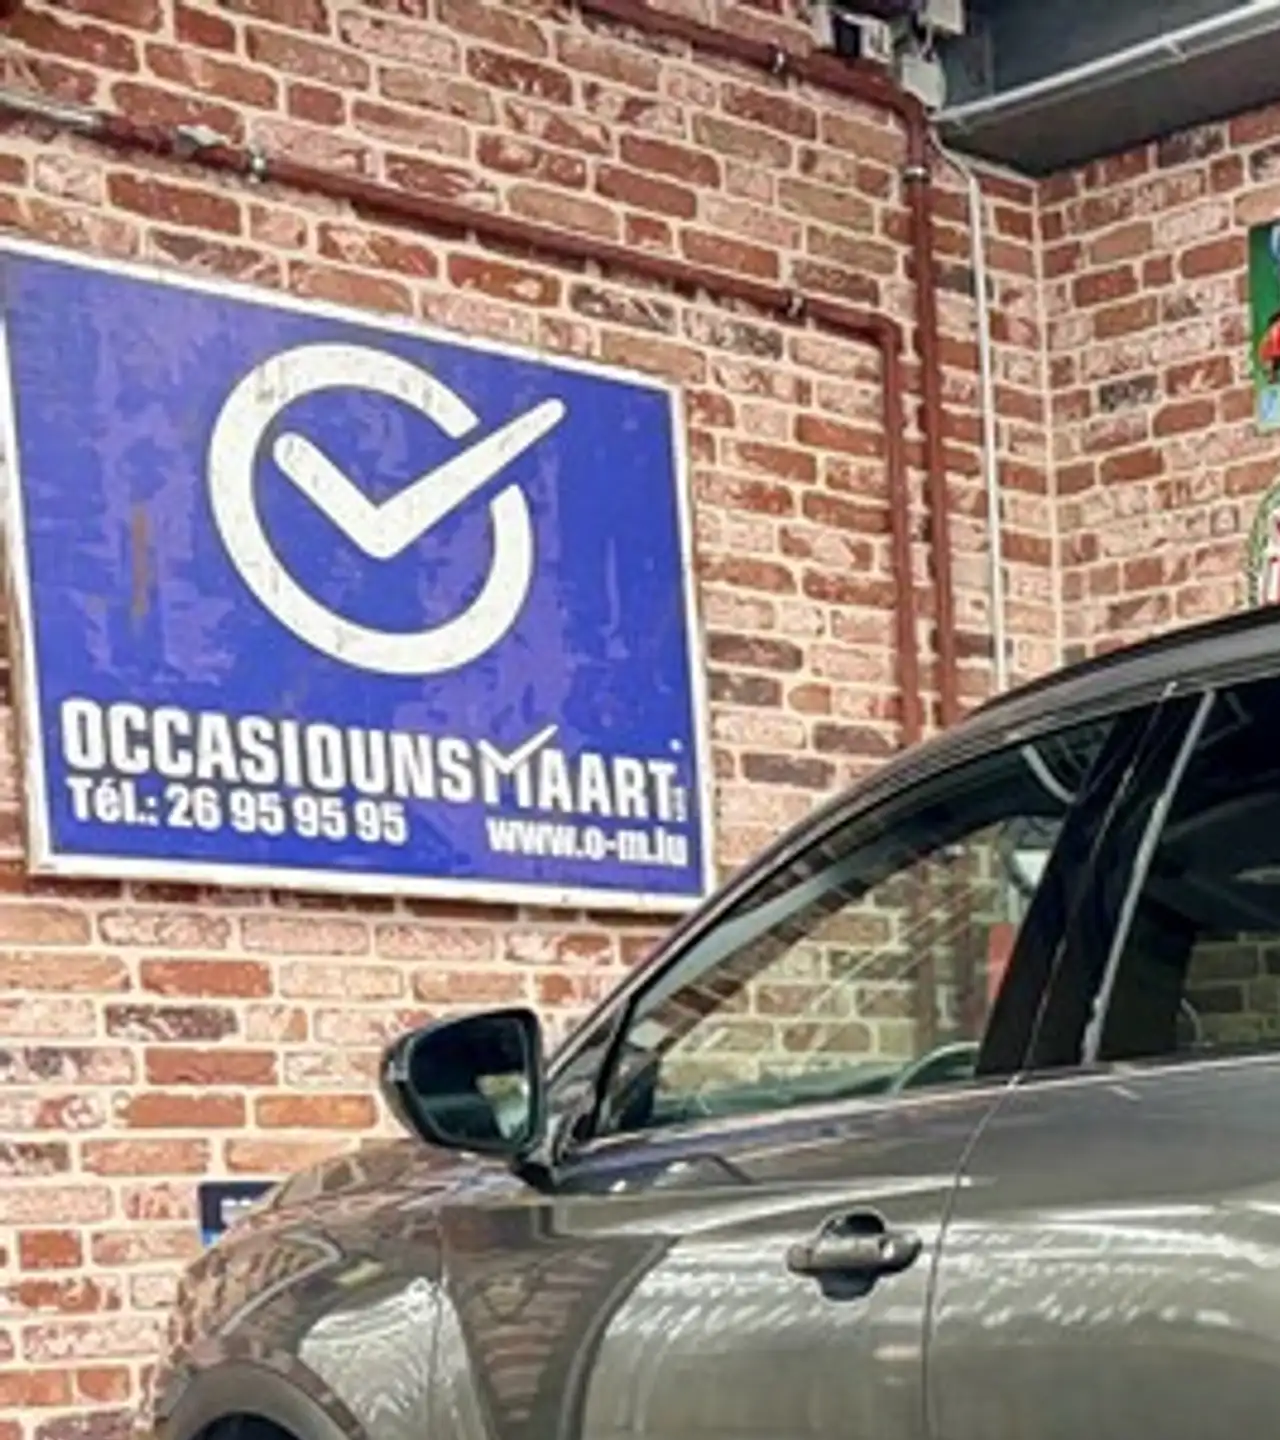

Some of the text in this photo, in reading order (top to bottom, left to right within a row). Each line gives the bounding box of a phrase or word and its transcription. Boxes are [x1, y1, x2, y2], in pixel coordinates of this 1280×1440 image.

[65, 776, 409, 845] Tél.: 26 95 95 95
[485, 817, 688, 867] www.o-m.lu
